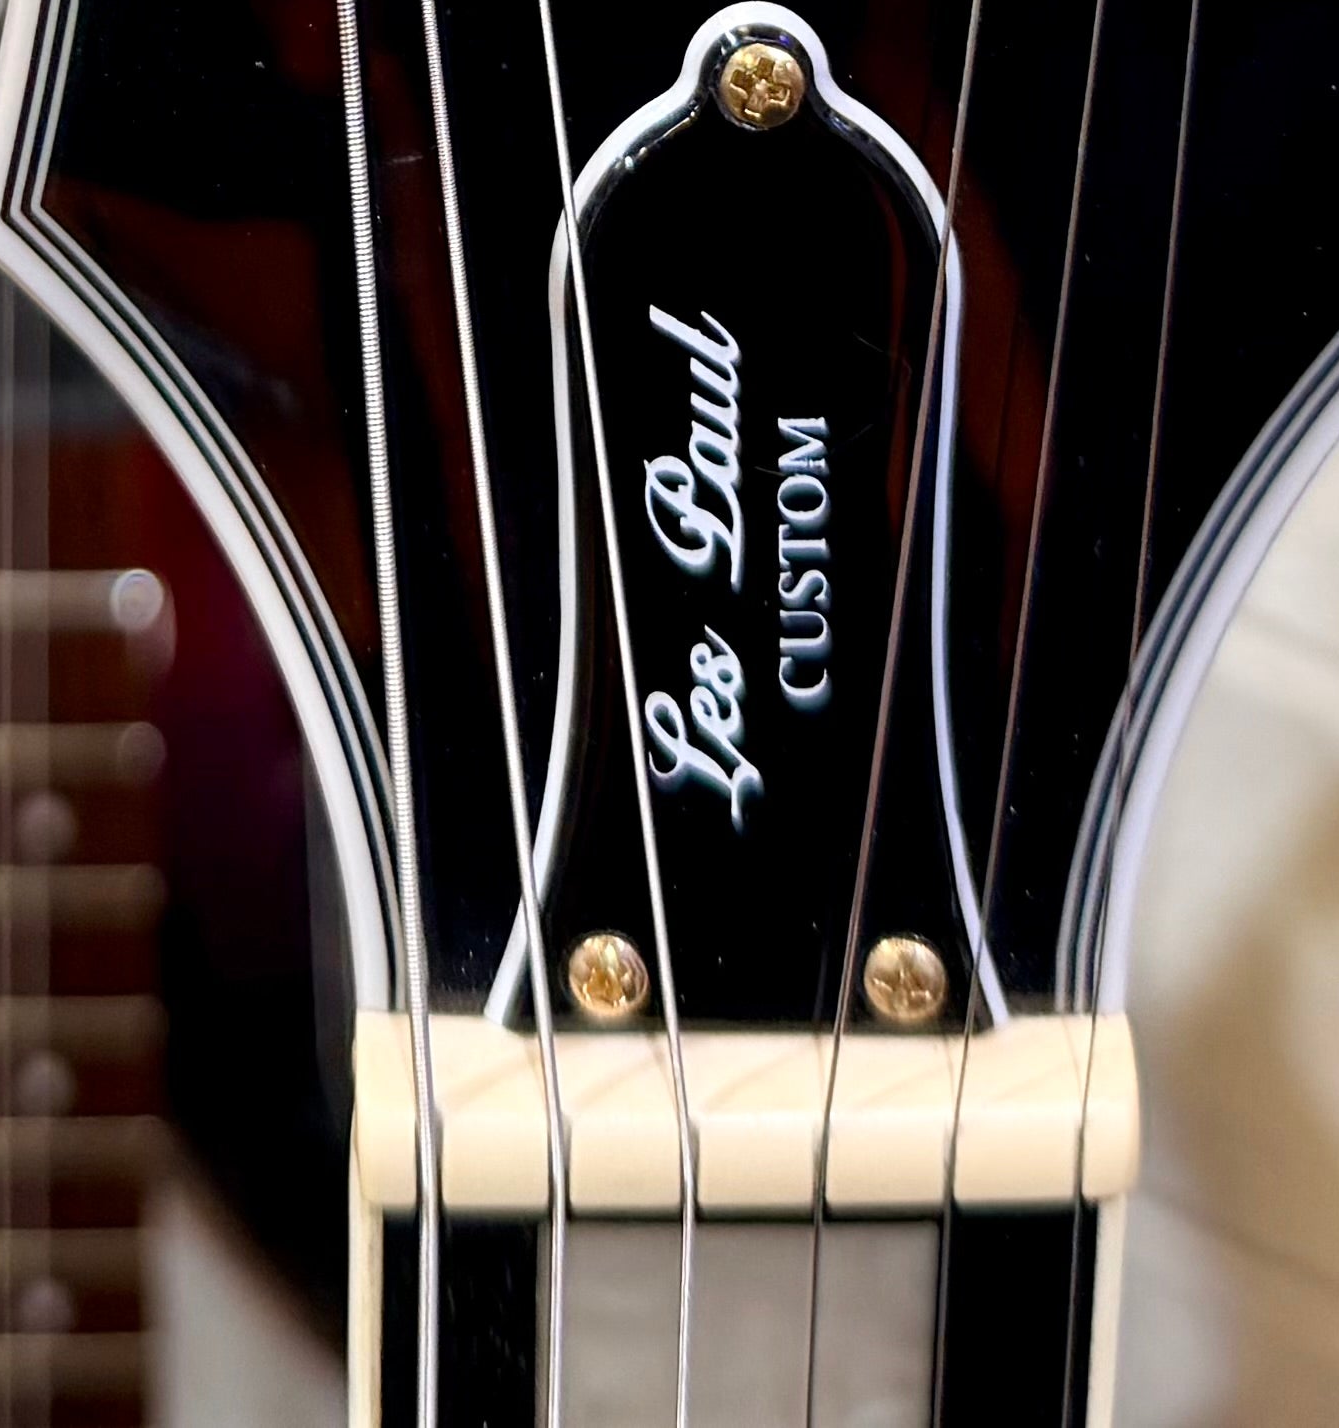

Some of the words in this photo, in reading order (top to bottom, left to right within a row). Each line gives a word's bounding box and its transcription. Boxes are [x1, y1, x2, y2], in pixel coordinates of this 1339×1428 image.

[643, 303, 744, 594] Paul
[776, 415, 831, 714] CUSTOM
[644, 624, 763, 834] Les
